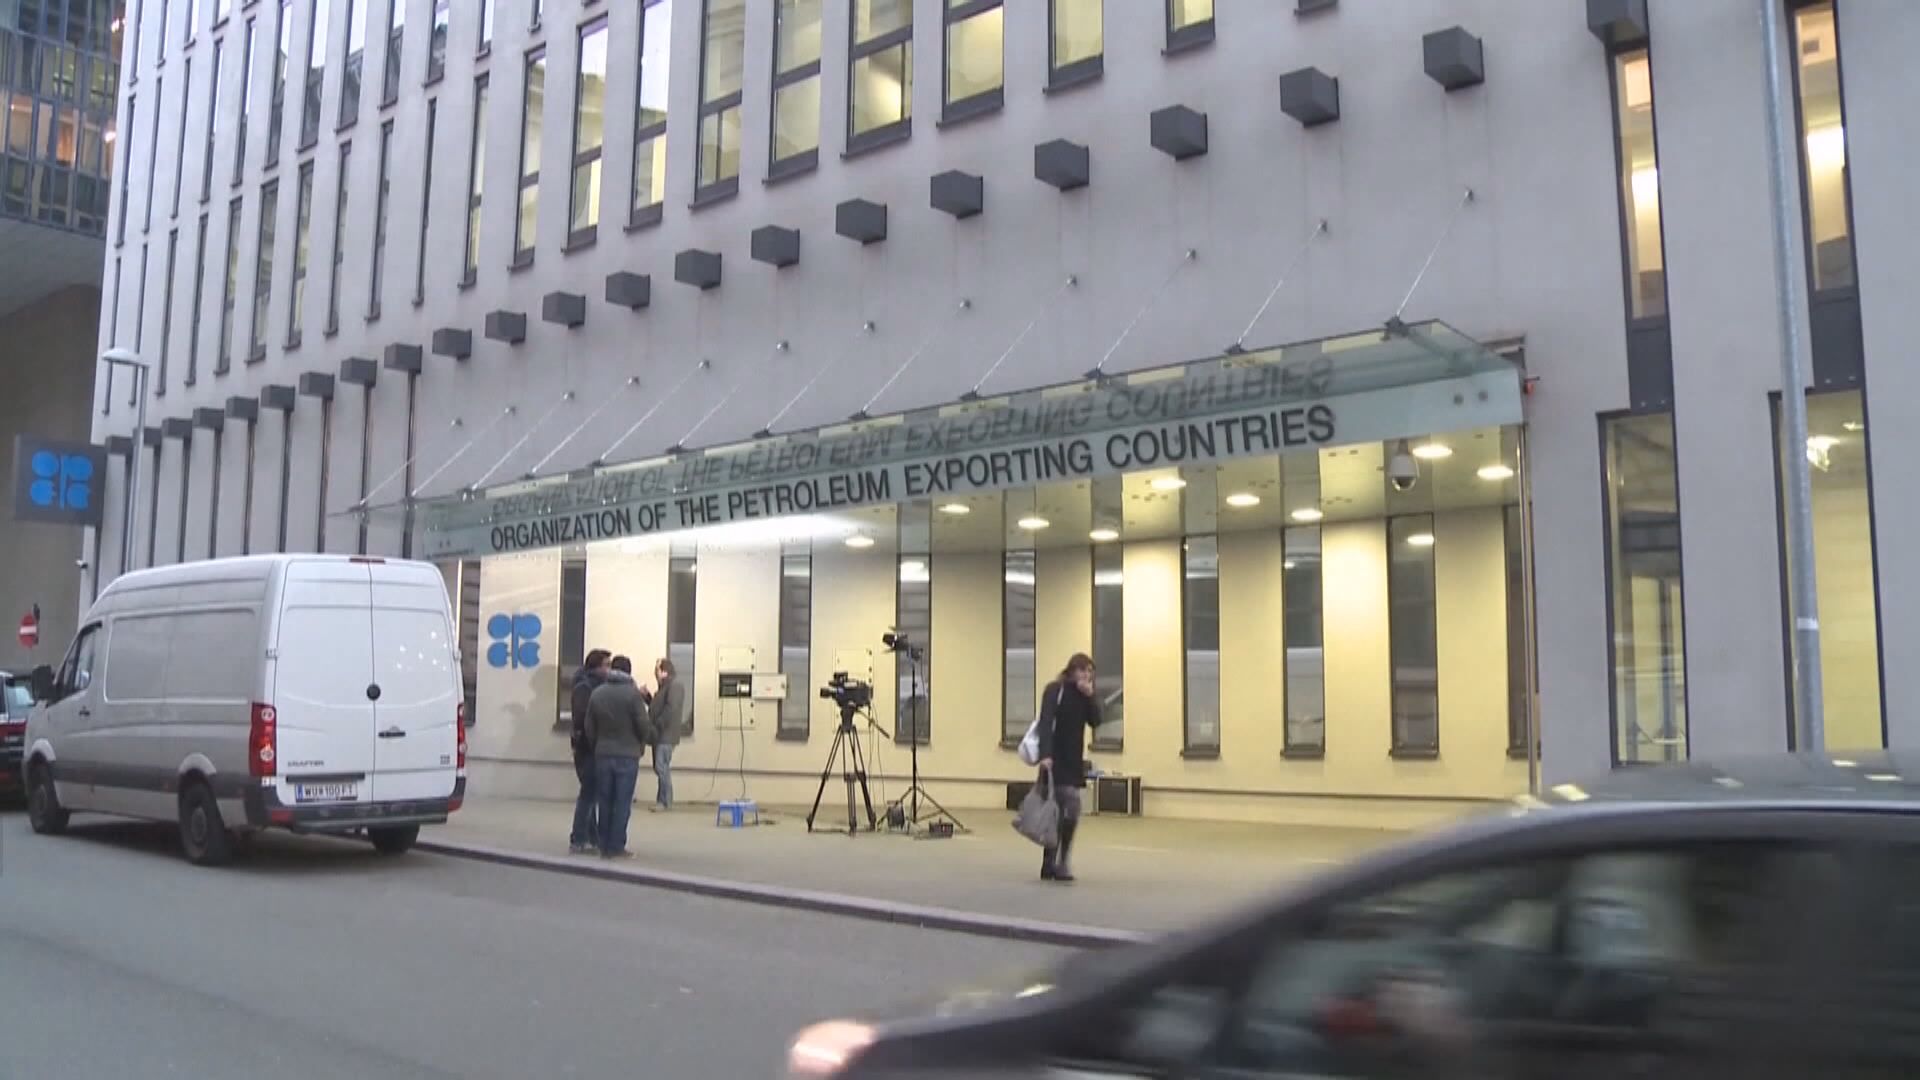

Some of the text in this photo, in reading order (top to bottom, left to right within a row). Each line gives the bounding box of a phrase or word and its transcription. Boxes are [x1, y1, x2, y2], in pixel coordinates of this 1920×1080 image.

[491, 405, 1336, 551] ORGANIZATION OF THE PETROLEUM EXPORTING COUNTRIES
